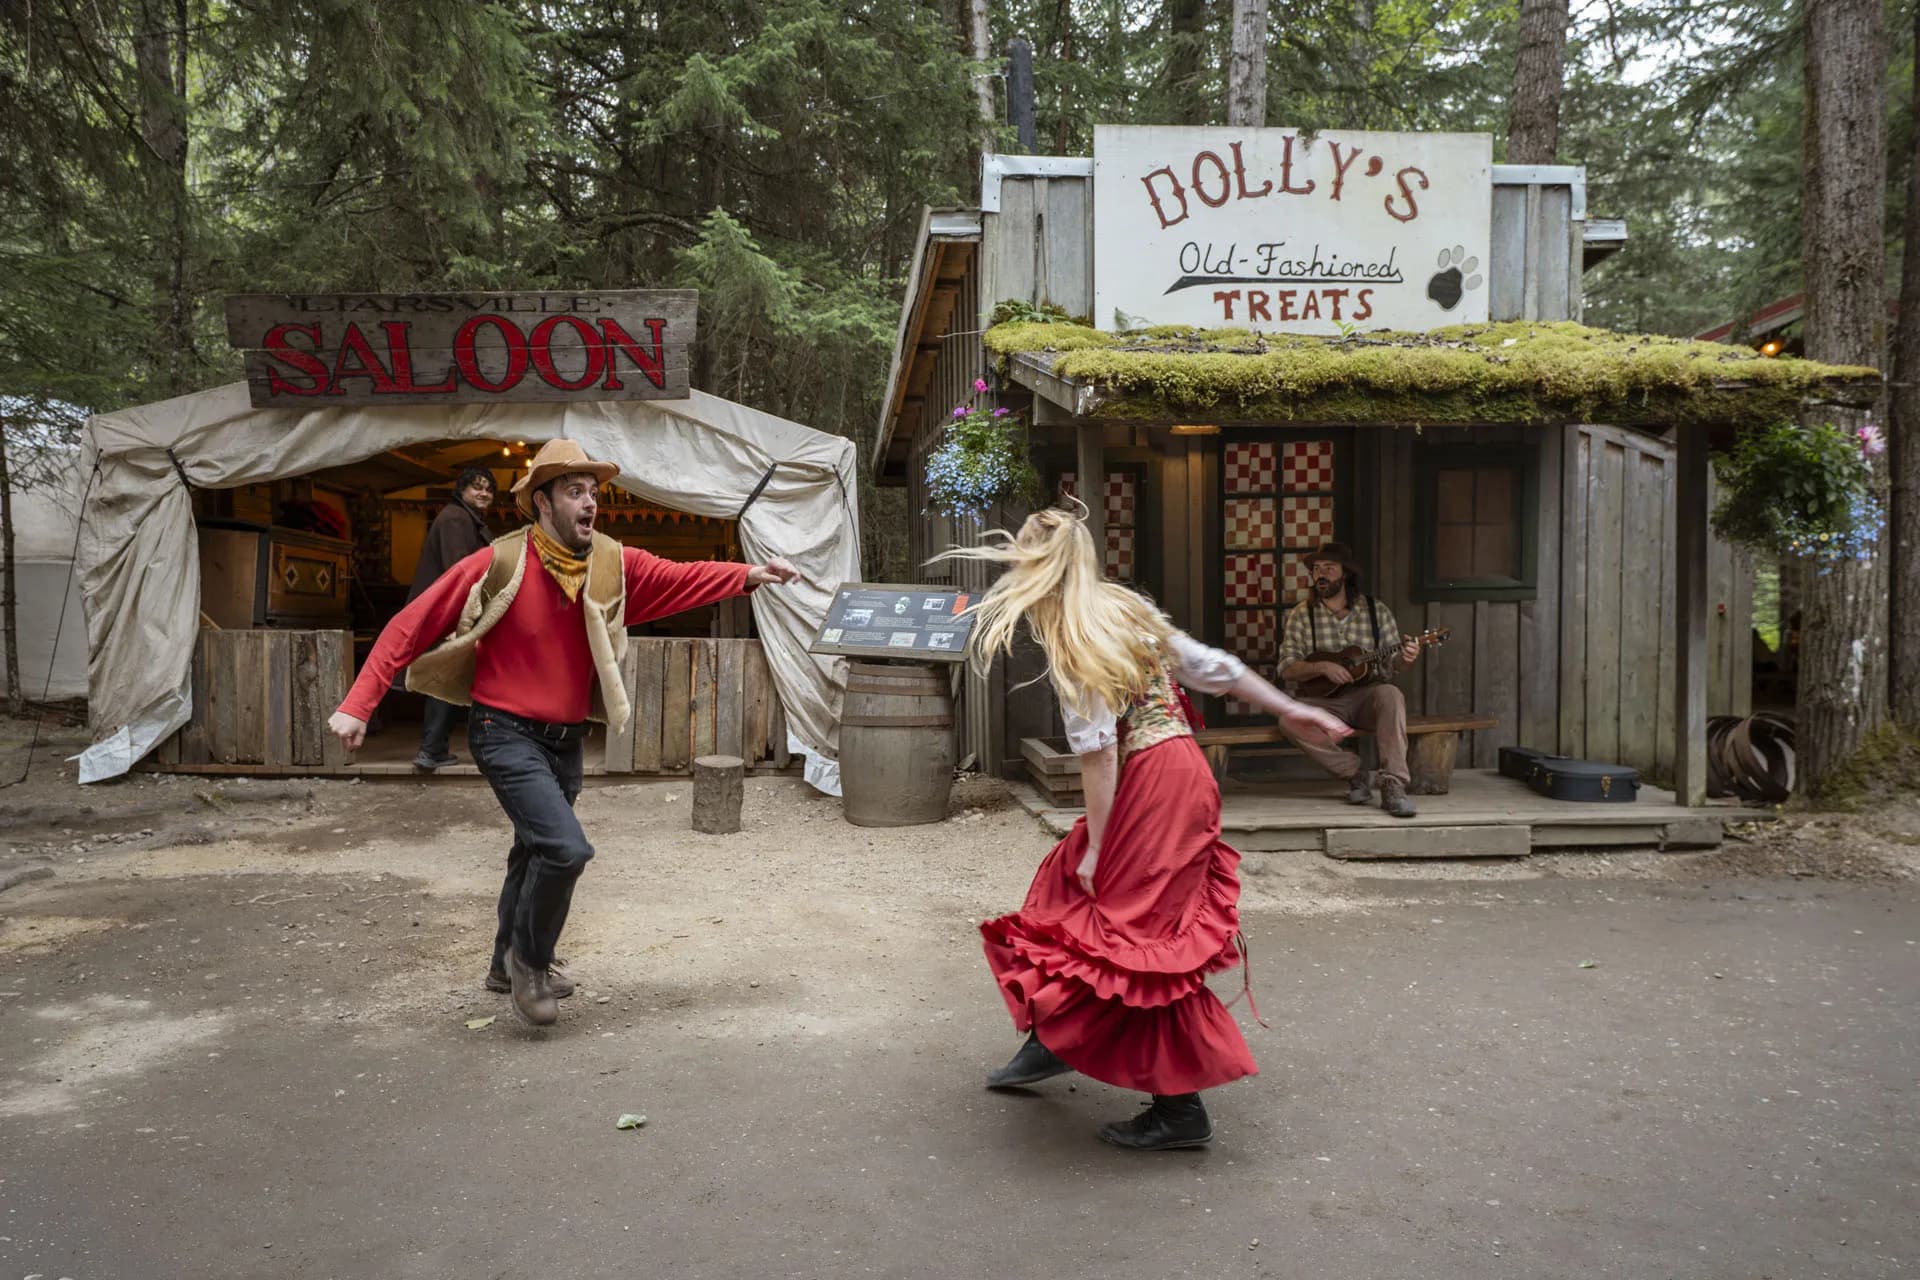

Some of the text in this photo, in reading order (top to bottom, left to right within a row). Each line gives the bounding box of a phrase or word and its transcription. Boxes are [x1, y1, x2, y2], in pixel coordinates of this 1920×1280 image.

[1141, 135, 1429, 229] DOLLY'S
[1179, 241, 1400, 278] Old-Fashioned
[298, 295, 600, 313] LIARSVILLE
[1213, 289, 1374, 322] TREATS
[262, 314, 667, 397] SALOON
